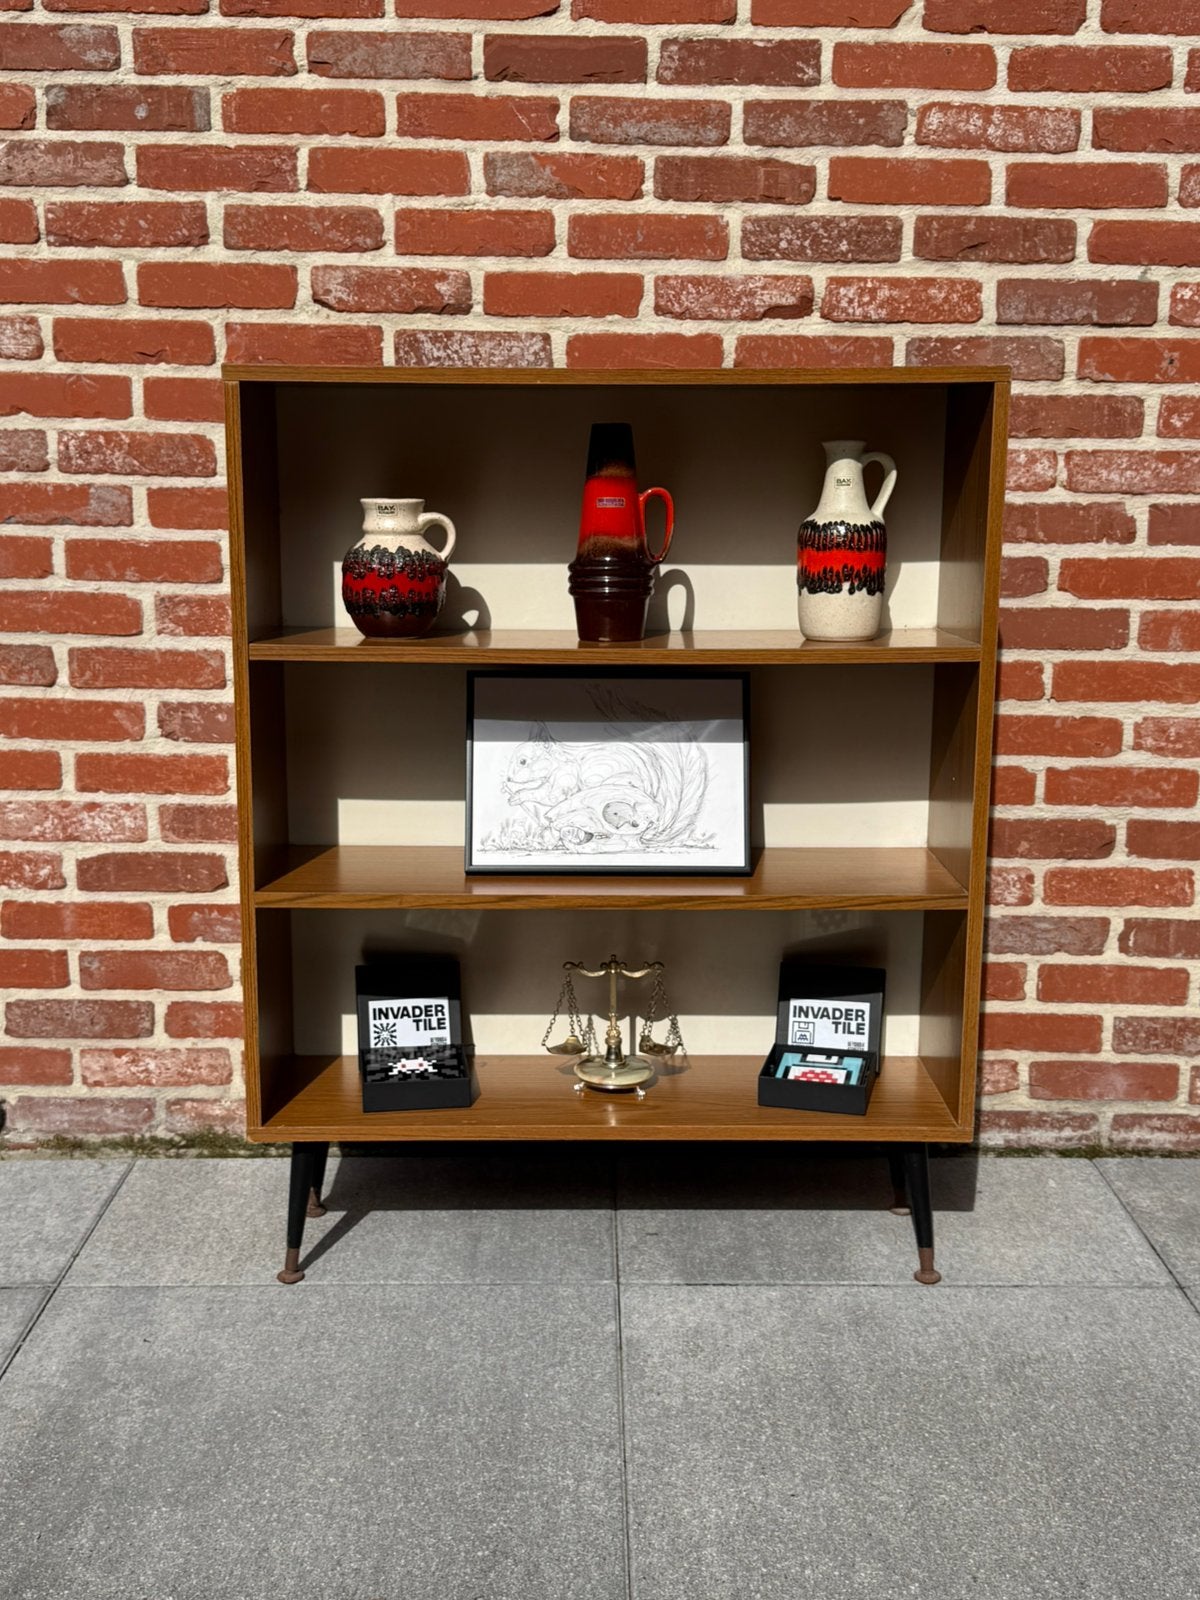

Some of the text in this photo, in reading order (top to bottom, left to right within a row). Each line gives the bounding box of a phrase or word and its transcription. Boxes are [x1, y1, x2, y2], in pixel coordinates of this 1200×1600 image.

[372, 1004, 446, 1021] INVADER
[792, 1005, 866, 1022] INVADER
[412, 1017, 447, 1032] TILE
[831, 1021, 866, 1036] TILE
